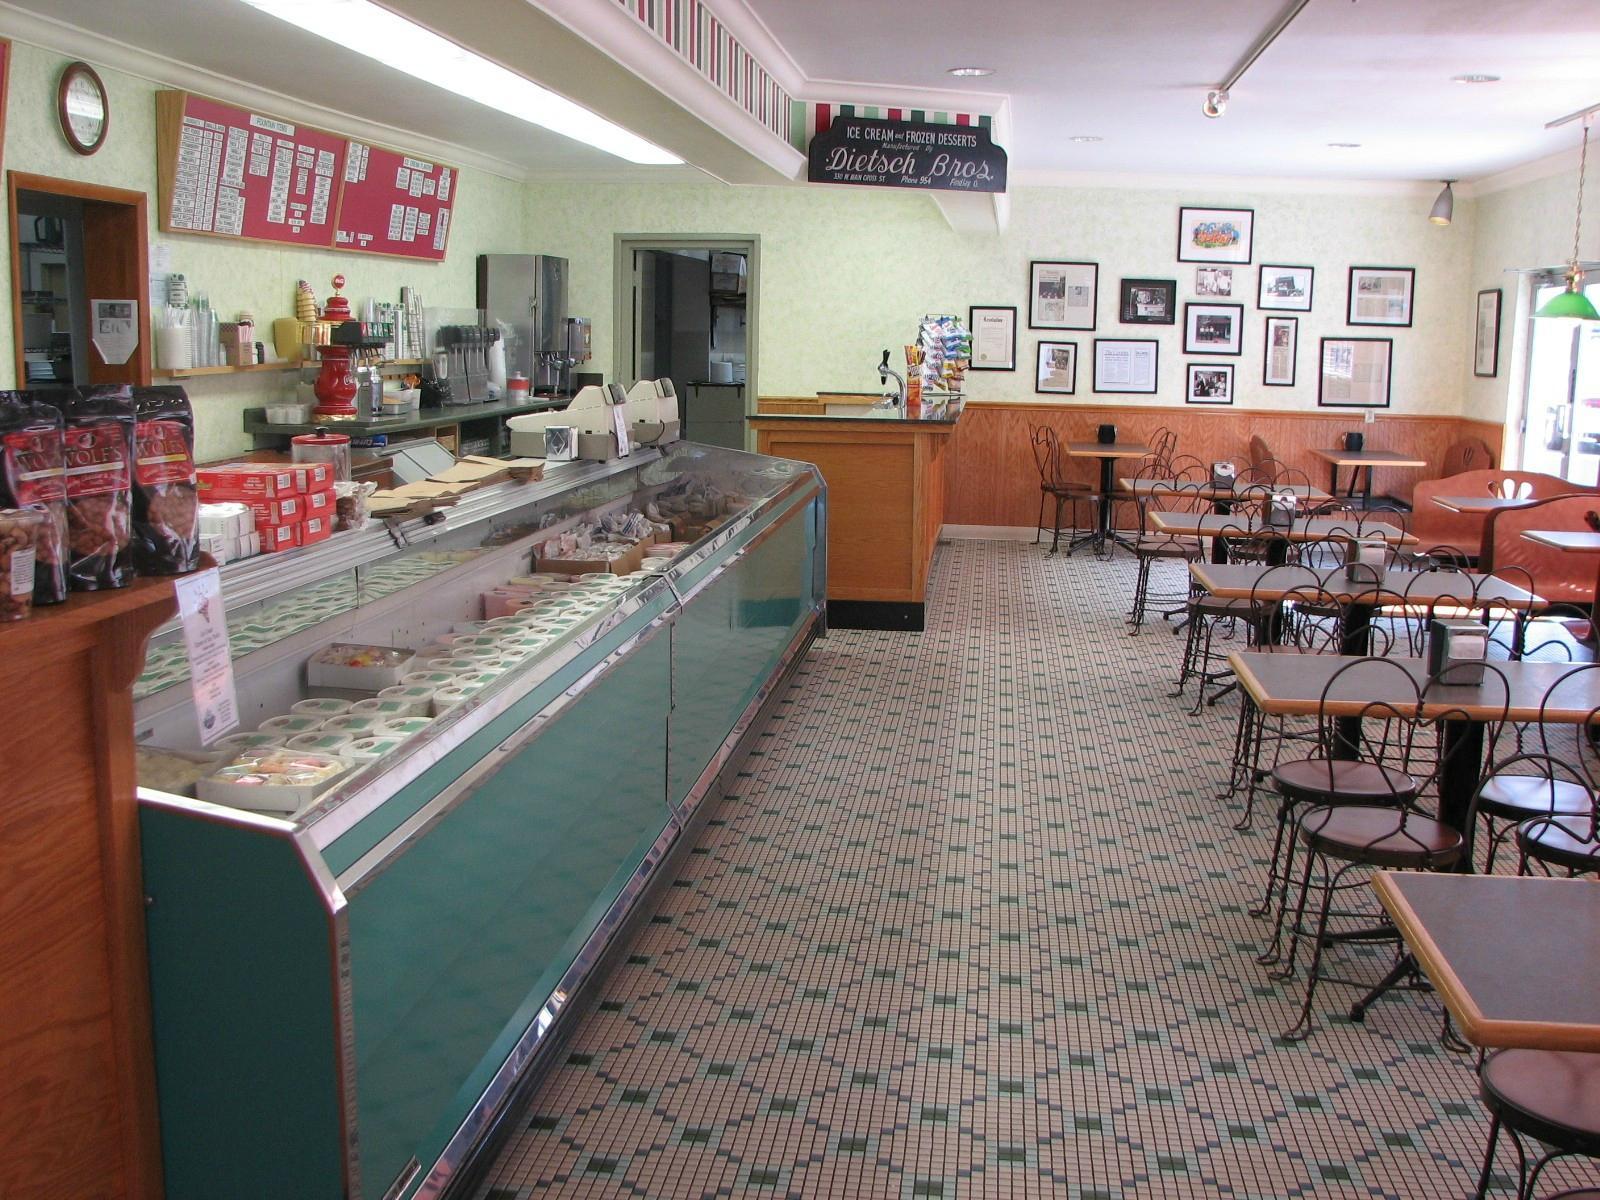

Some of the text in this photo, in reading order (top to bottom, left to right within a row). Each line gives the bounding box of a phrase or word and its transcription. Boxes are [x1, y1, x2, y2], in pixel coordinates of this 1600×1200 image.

[847, 126, 860, 139] ICE
[864, 127, 894, 142] CREAM
[905, 131, 936, 145] FROZEN
[938, 133, 977, 148] DESSERTS
[826, 146, 916, 175] Dietsch
